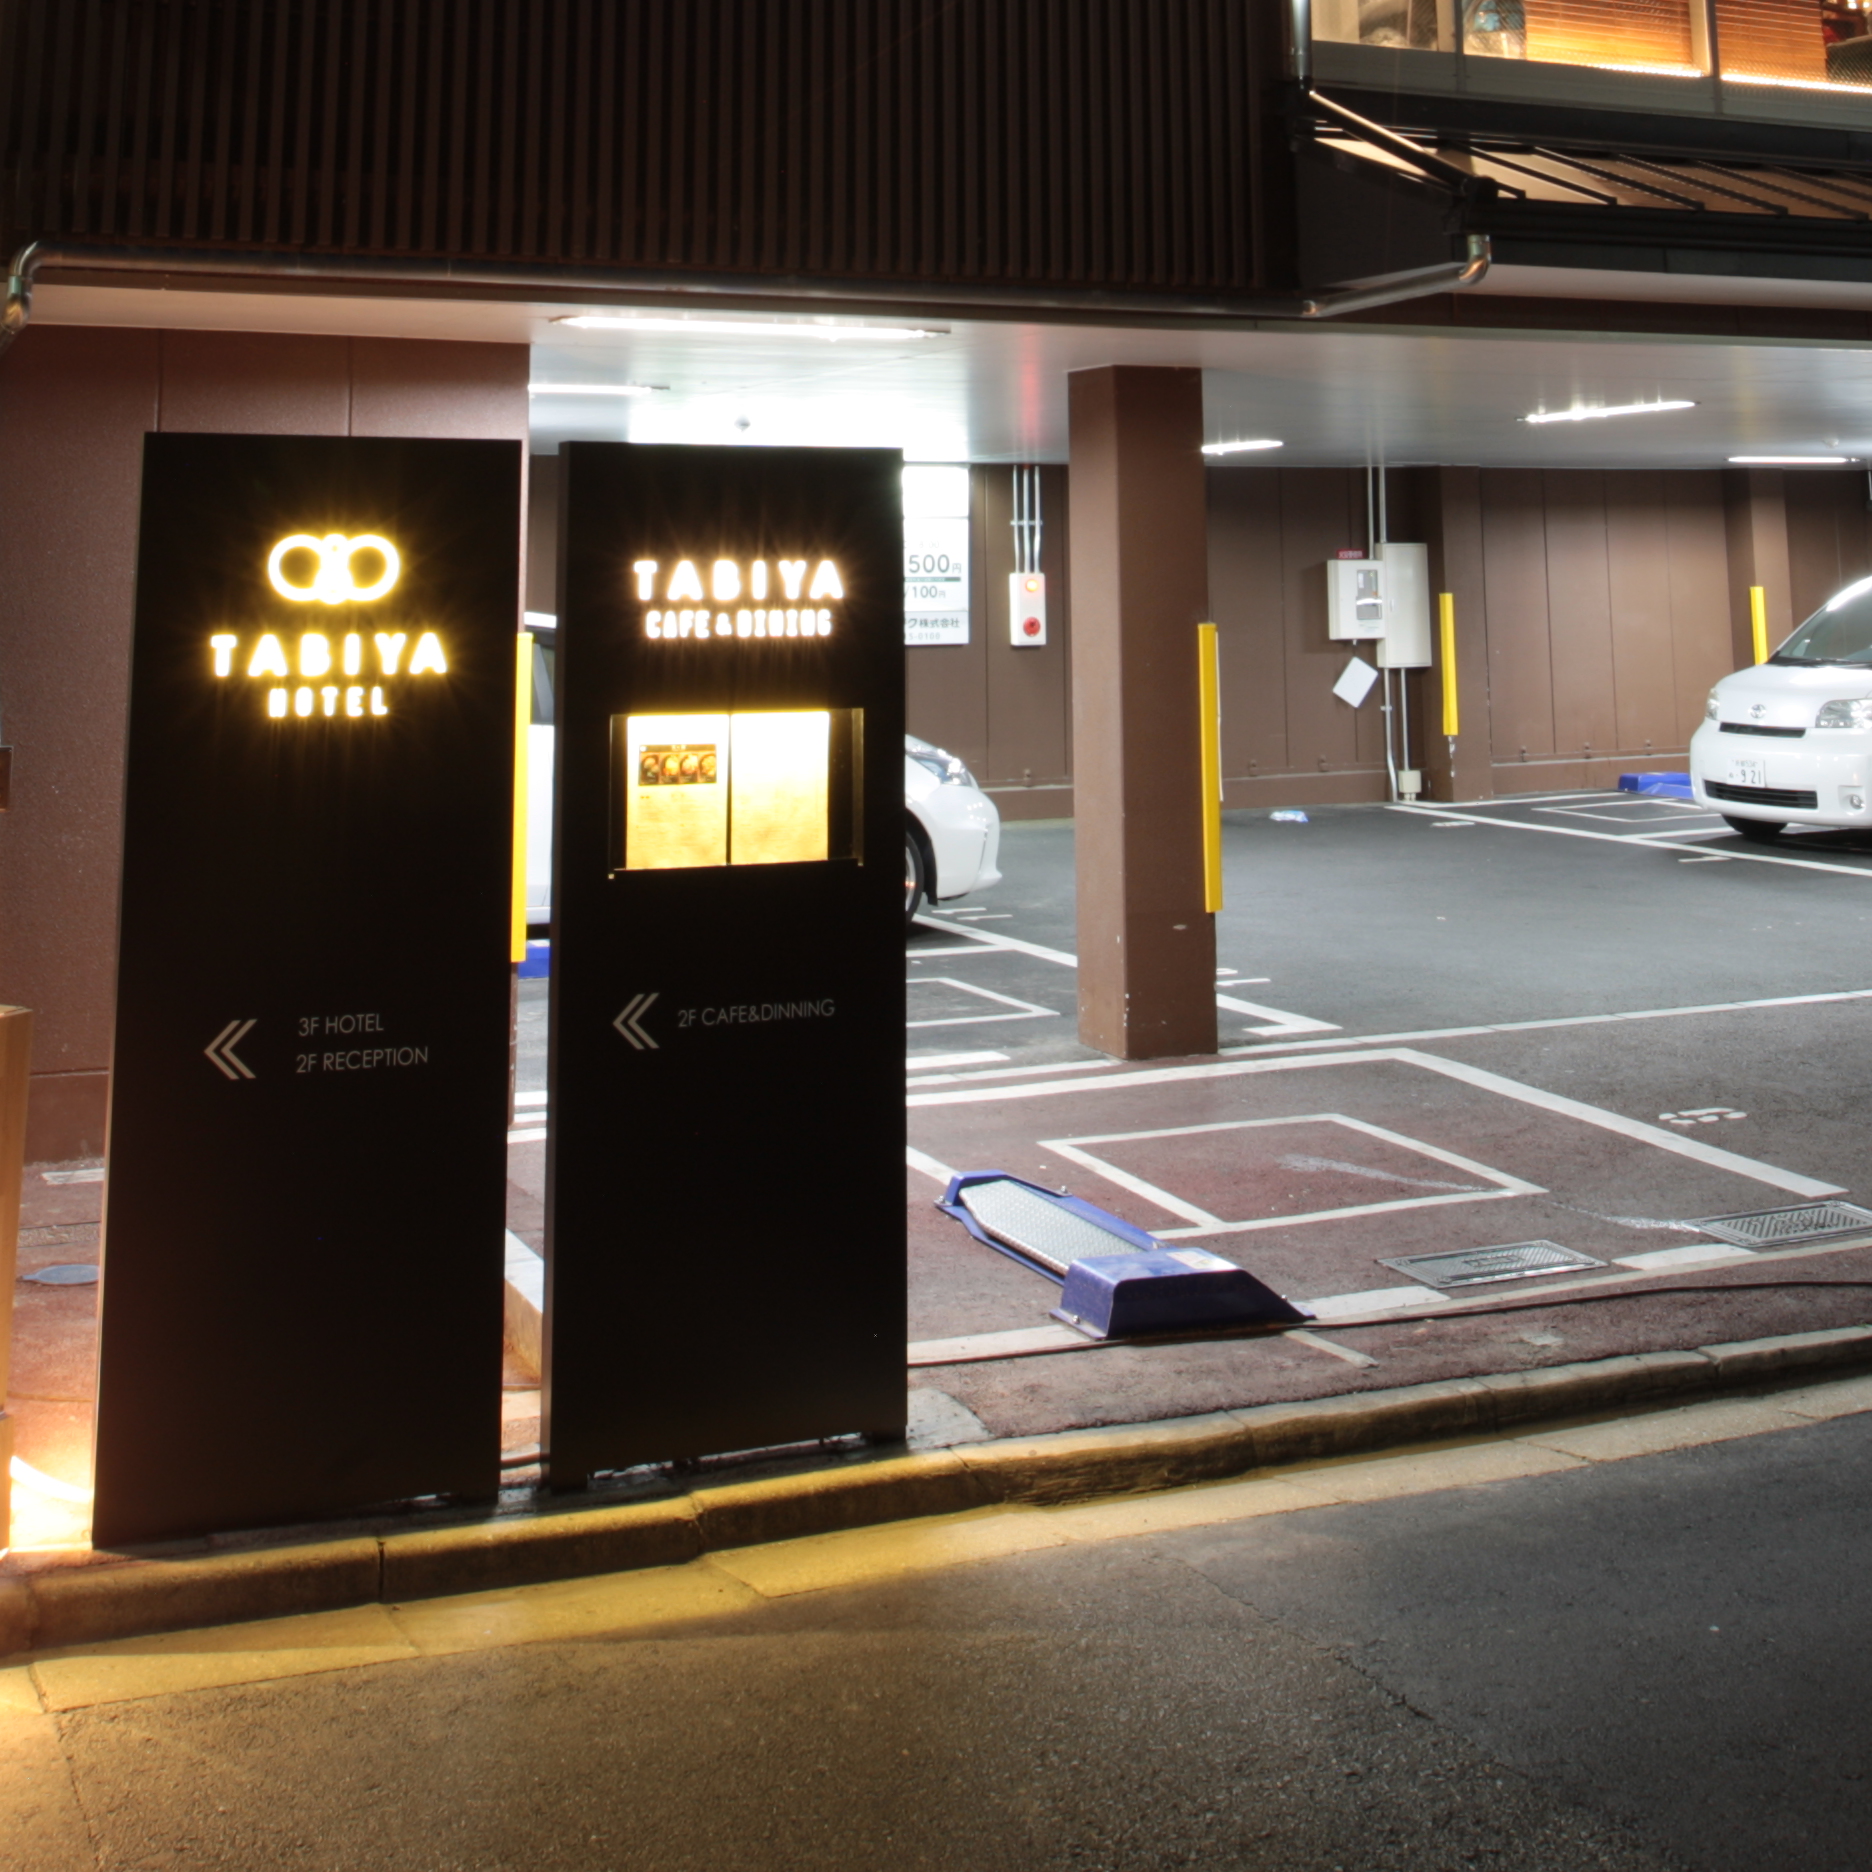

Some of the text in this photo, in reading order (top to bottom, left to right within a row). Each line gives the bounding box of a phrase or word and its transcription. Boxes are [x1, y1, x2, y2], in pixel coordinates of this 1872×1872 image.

[632, 559, 844, 603] TABIYA
[646, 611, 708, 640] CAFE
[737, 611, 832, 638] DINING
[905, 618, 960, 628] ク株式会社
[211, 631, 448, 678] TABIYA
[268, 687, 389, 720] HOTEL
[298, 1012, 384, 1036] 3F HOTEL
[678, 998, 836, 1028] 2F CAFE&DINNING
[296, 1046, 429, 1075] 2F RECEPTION
